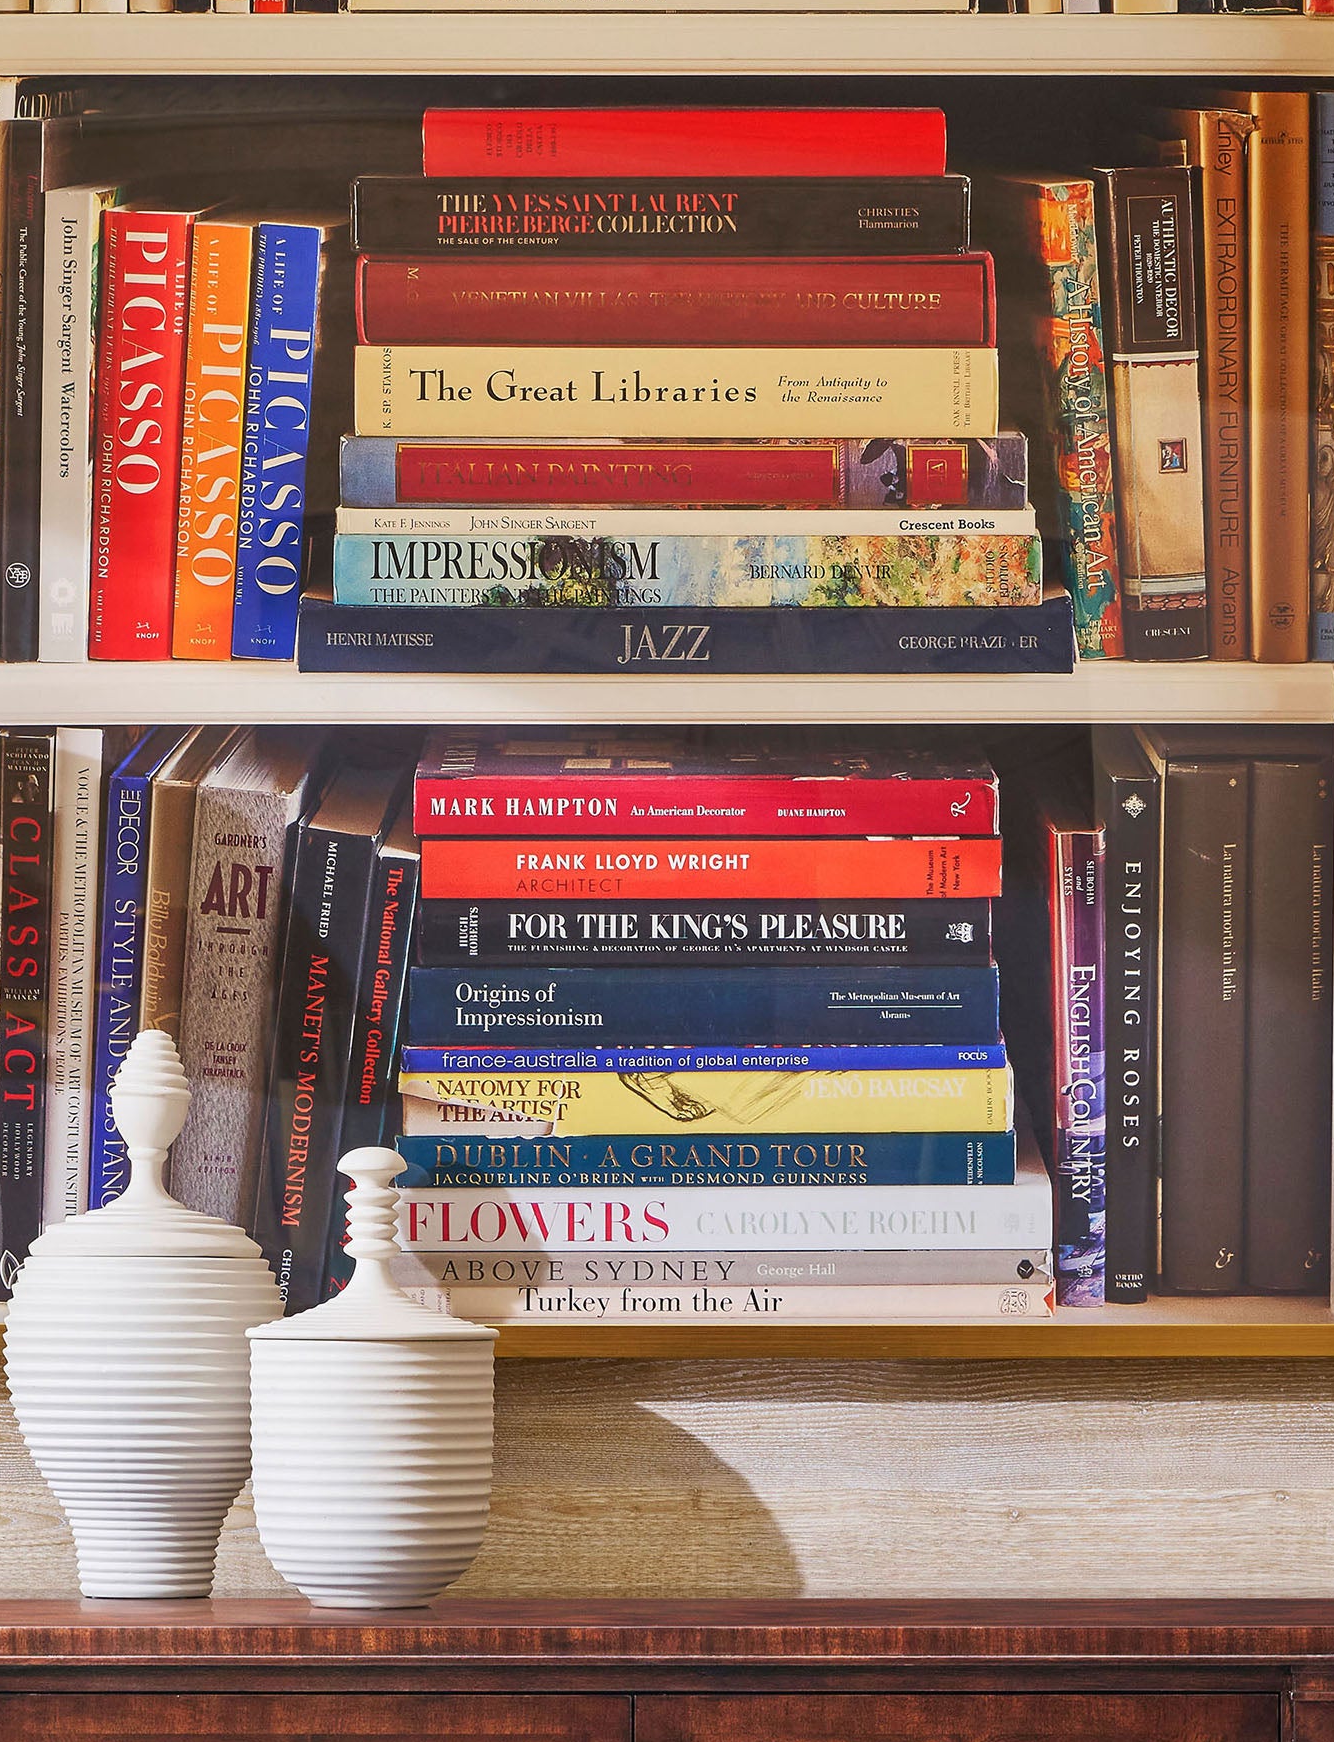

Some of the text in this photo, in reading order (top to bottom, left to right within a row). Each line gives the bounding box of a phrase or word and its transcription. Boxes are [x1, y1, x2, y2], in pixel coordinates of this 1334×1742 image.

[857, 207, 920, 217] CHRISTIE'S
[858, 219, 919, 229] Flammarion
[437, 237, 559, 245] THE SALE OF THE CENTURY
[56, 216, 78, 478] John Singer Sargent Watercolors
[115, 228, 169, 495] PICASSO
[1216, 197, 1239, 548] EXTRAORDINARY FURNITURE
[409, 368, 757, 403] The Great Libraries
[777, 375, 888, 393] From Antiquity to
[781, 389, 883, 403] the Renaissance
[1065, 277, 1109, 590] A History of American Art
[191, 322, 245, 586] PICASSO
[238, 363, 263, 549] JOHN RICHARDSON
[254, 324, 311, 594] PICASSO
[98, 433, 113, 579] JOHN RICHARDSON
[469, 515, 597, 532] JOHN SINGER SARGENT
[899, 518, 996, 531] Crescent Books
[1221, 567, 1240, 646] Abrams
[326, 632, 434, 647] HENRI MATISSE
[617, 624, 711, 665] JAZZ
[430, 797, 618, 817] MARK HAMPTON
[630, 805, 747, 817] An American Decorator
[214, 832, 267, 850] GARDNER'S
[516, 854, 750, 870] FRANK LLOYD WRIGHT
[199, 860, 274, 920] ART
[318, 841, 338, 938] MICHAEL FRIED
[515, 878, 622, 893] ARCHITECT
[507, 913, 906, 940] FOR THE KING'S PLEASURE
[3, 816, 41, 1111] CLASS ACT
[359, 867, 404, 1104] The National Gallery Collection
[455, 982, 557, 1009] Origins of
[1121, 861, 1142, 1147] ENJOYING ROSES
[455, 1006, 604, 1032] Impressionism
[441, 1051, 598, 1067] france-australia
[605, 1054, 809, 1069] a tradition of global enterprise
[958, 1051, 988, 1061] FOCUS
[281, 954, 329, 1227] MANET'S MODERNISM
[1062, 963, 1097, 1204] ENGLISH COUNTRY
[436, 1144, 868, 1168] DUBLIN A GRAND TOUR
[405, 1201, 669, 1243] FLOWERS
[440, 1260, 736, 1281] ABOVE SYDNEY
[756, 1263, 836, 1279] George Hall
[518, 1285, 783, 1318] Turkey from the Air
